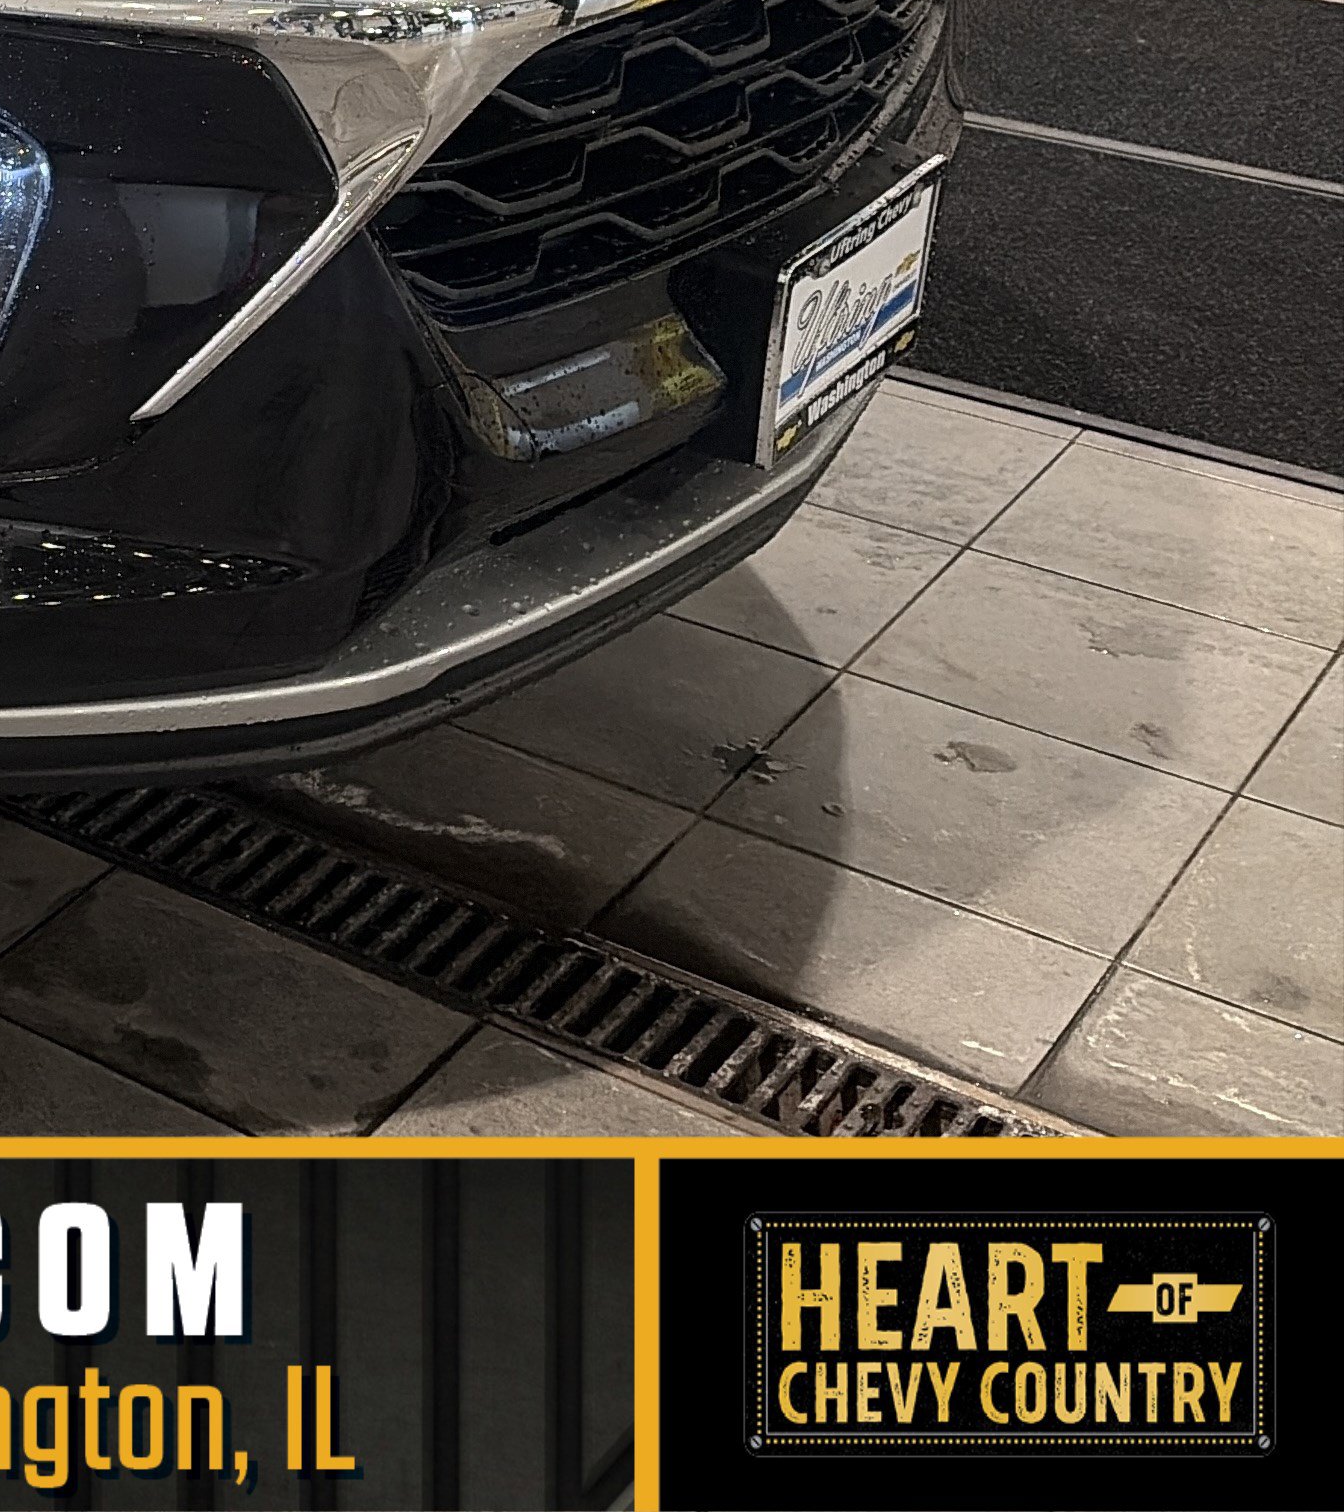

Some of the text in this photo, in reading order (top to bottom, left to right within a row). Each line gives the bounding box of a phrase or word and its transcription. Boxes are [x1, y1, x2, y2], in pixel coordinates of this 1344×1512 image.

[830, 192, 913, 264] Uftring Chevy
[807, 349, 886, 426] Washington
